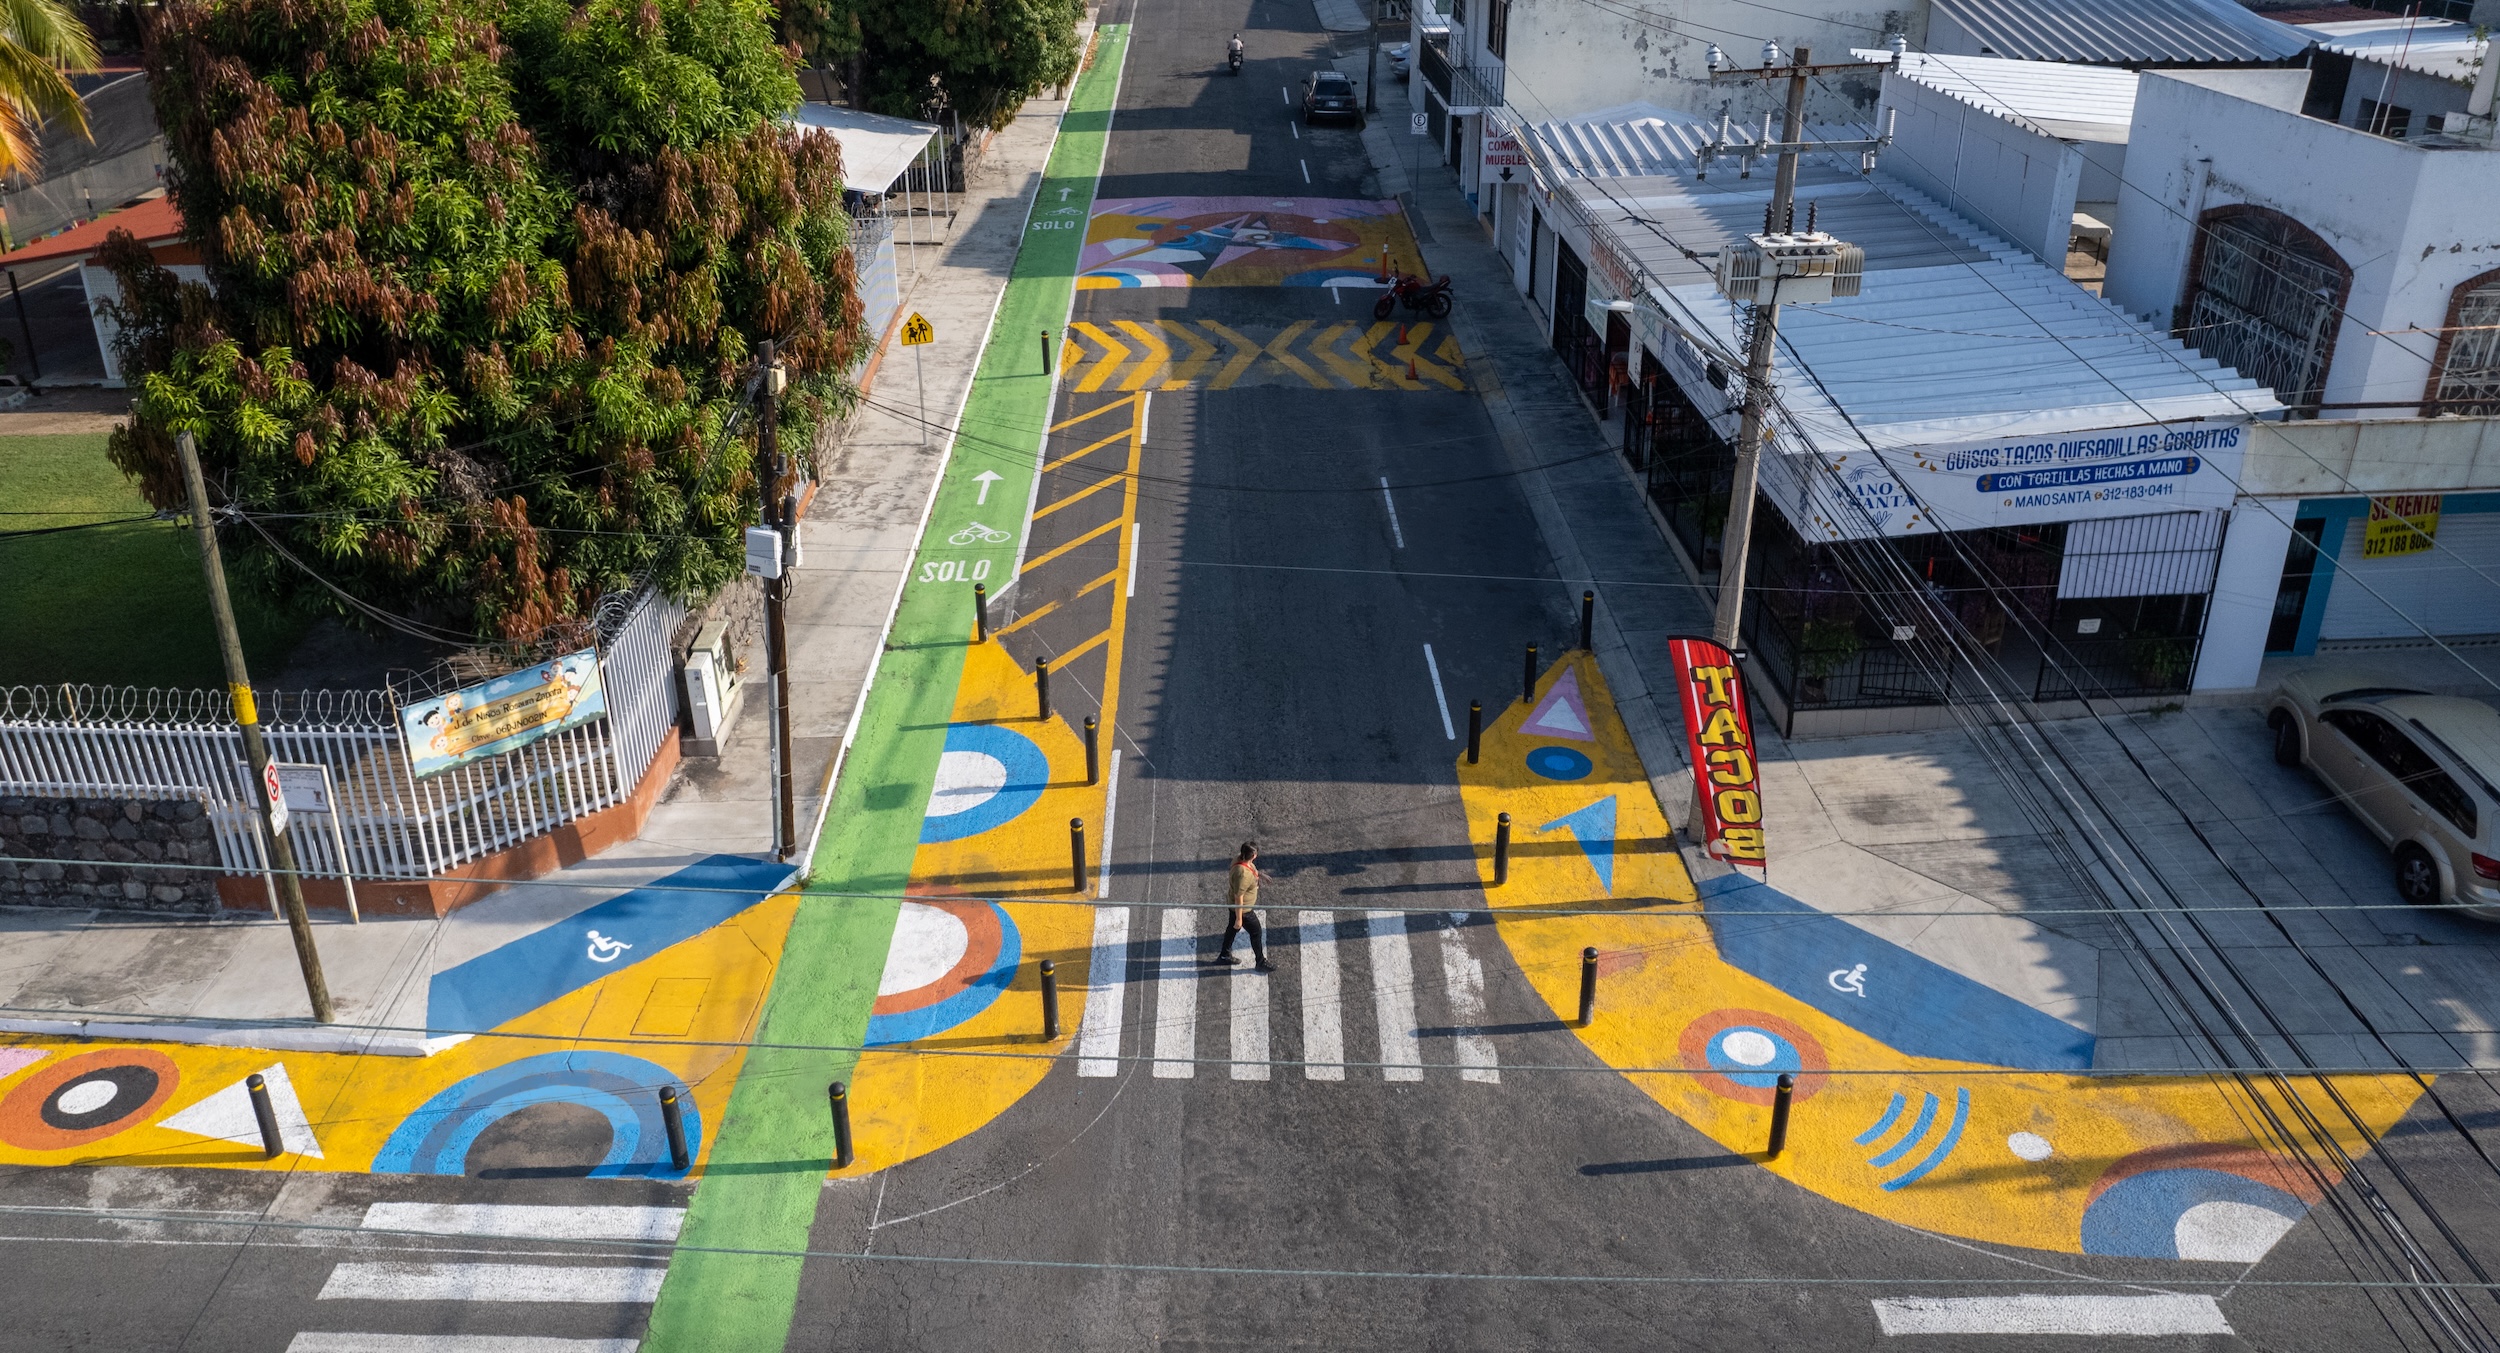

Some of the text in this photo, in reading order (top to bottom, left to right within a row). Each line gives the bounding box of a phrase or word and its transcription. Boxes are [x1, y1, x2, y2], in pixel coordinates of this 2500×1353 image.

[1032, 220, 1075, 231] SOLO
[1946, 427, 2240, 471] GUISOS TACOS QUESADILLAS GORDITAS
[1998, 459, 2183, 489] CON TORTILLAS HECHAS A MANO
[2371, 495, 2439, 521] SE RENTA
[2365, 537, 2386, 555] 312
[2389, 535, 2407, 552] 188
[918, 559, 992, 583] SOLO
[535, 688, 562, 702] Zapata
